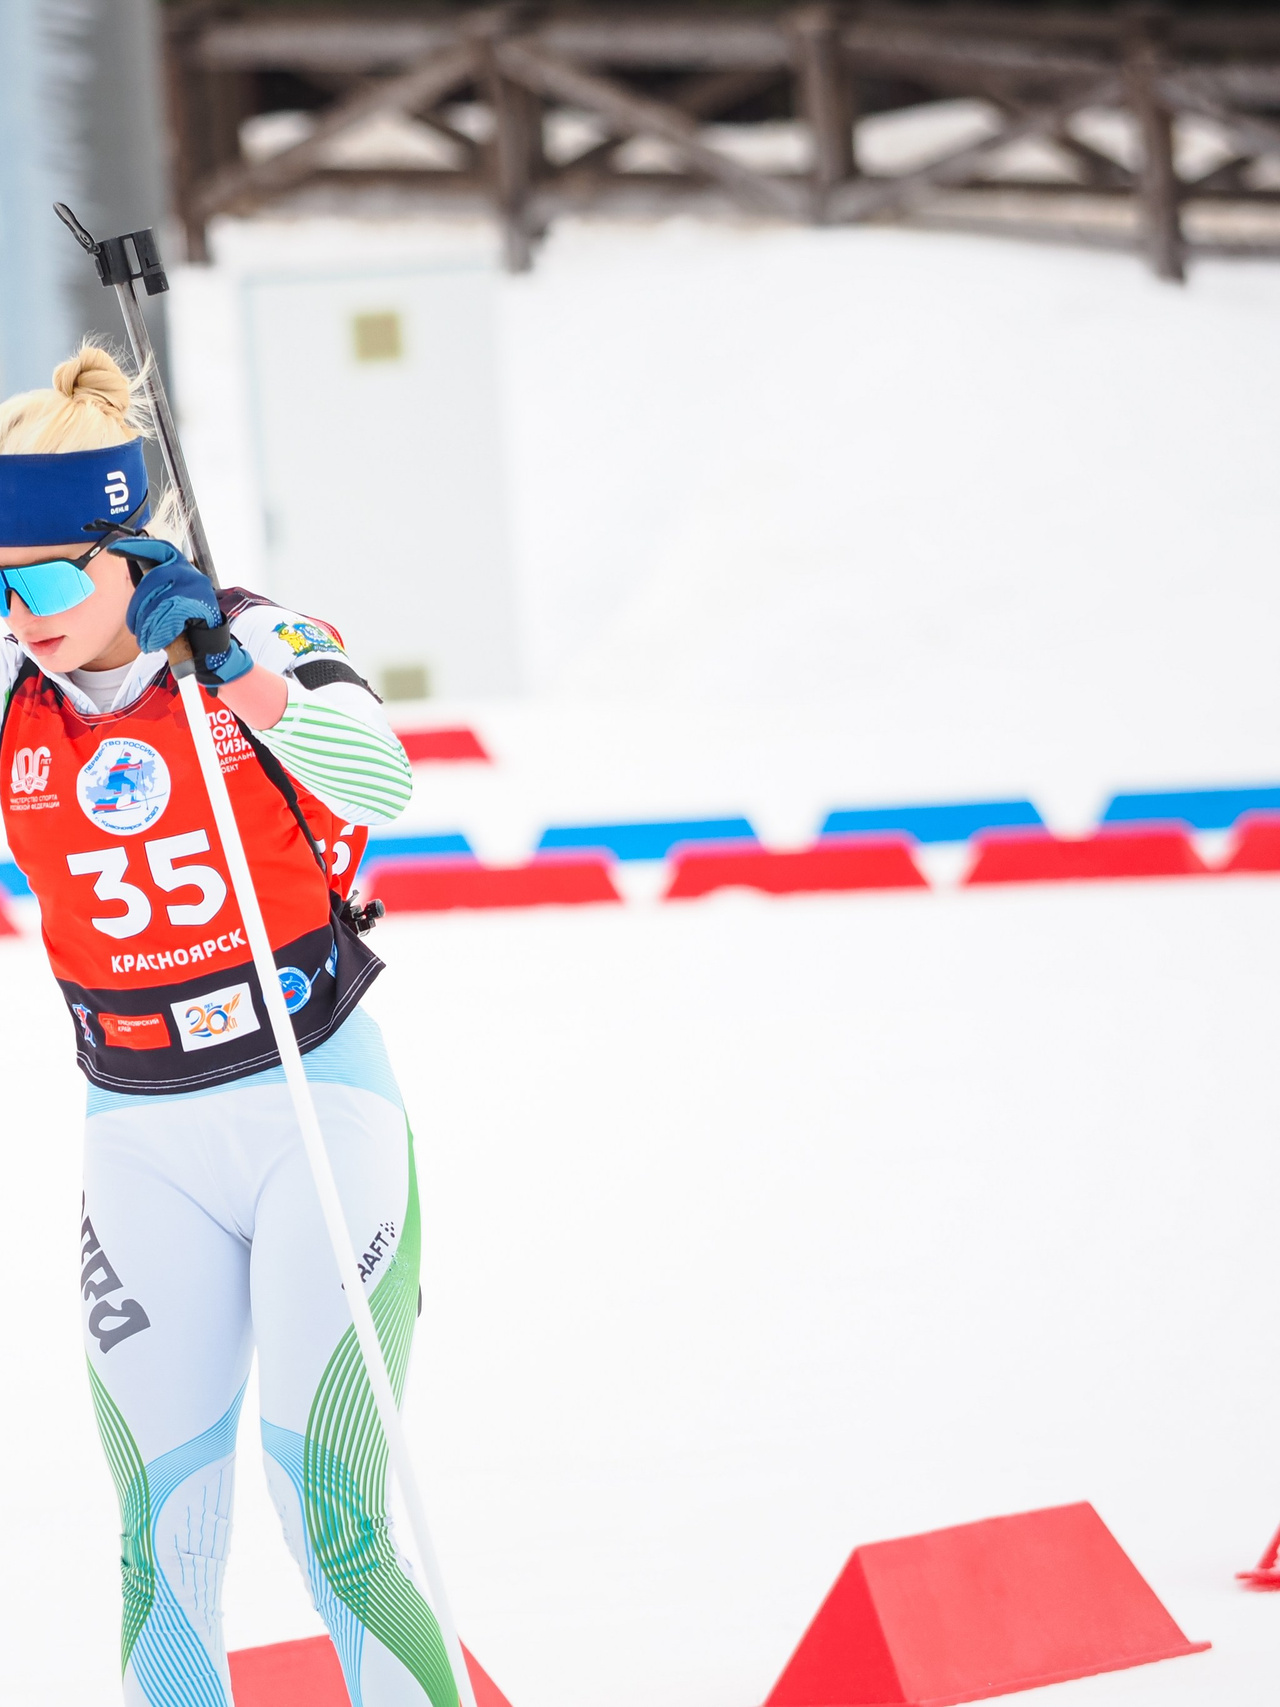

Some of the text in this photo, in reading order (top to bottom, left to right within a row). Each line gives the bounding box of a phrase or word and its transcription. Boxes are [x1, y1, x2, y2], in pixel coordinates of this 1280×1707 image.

[123, 741, 155, 758] РОССИИ
[39, 794, 58, 802] СПОРТА
[66, 828, 228, 939] 35
[111, 928, 247, 973] КРАСНОЯРСК
[341, 1231, 389, 1290] RAFT
